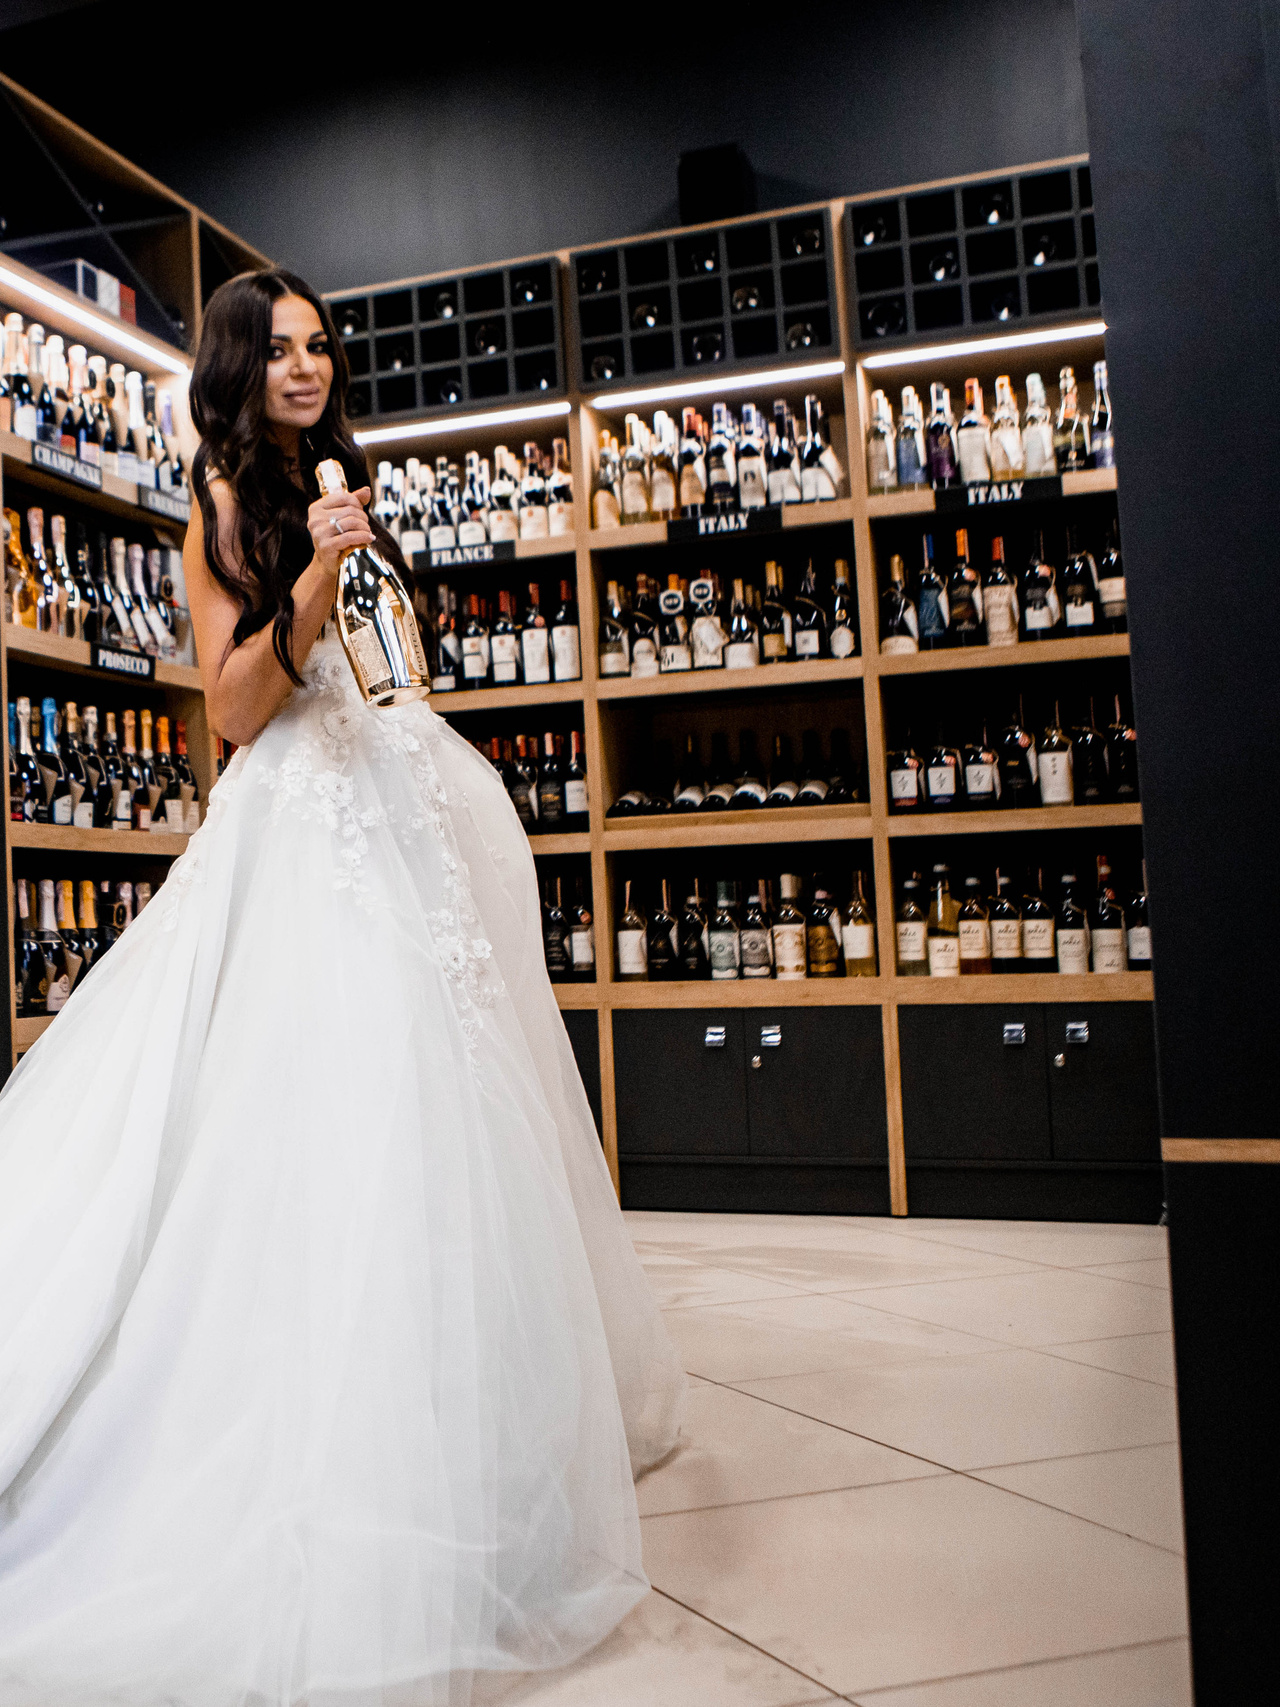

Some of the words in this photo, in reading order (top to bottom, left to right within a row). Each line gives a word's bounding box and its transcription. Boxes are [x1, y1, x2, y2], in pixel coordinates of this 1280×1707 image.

[968, 482, 1024, 505] ITALY
[699, 513, 748, 535] ITALY
[431, 544, 494, 567] FRANCE
[408, 622, 424, 671] BOTTEGA
[99, 649, 150, 675] PROSECCO
